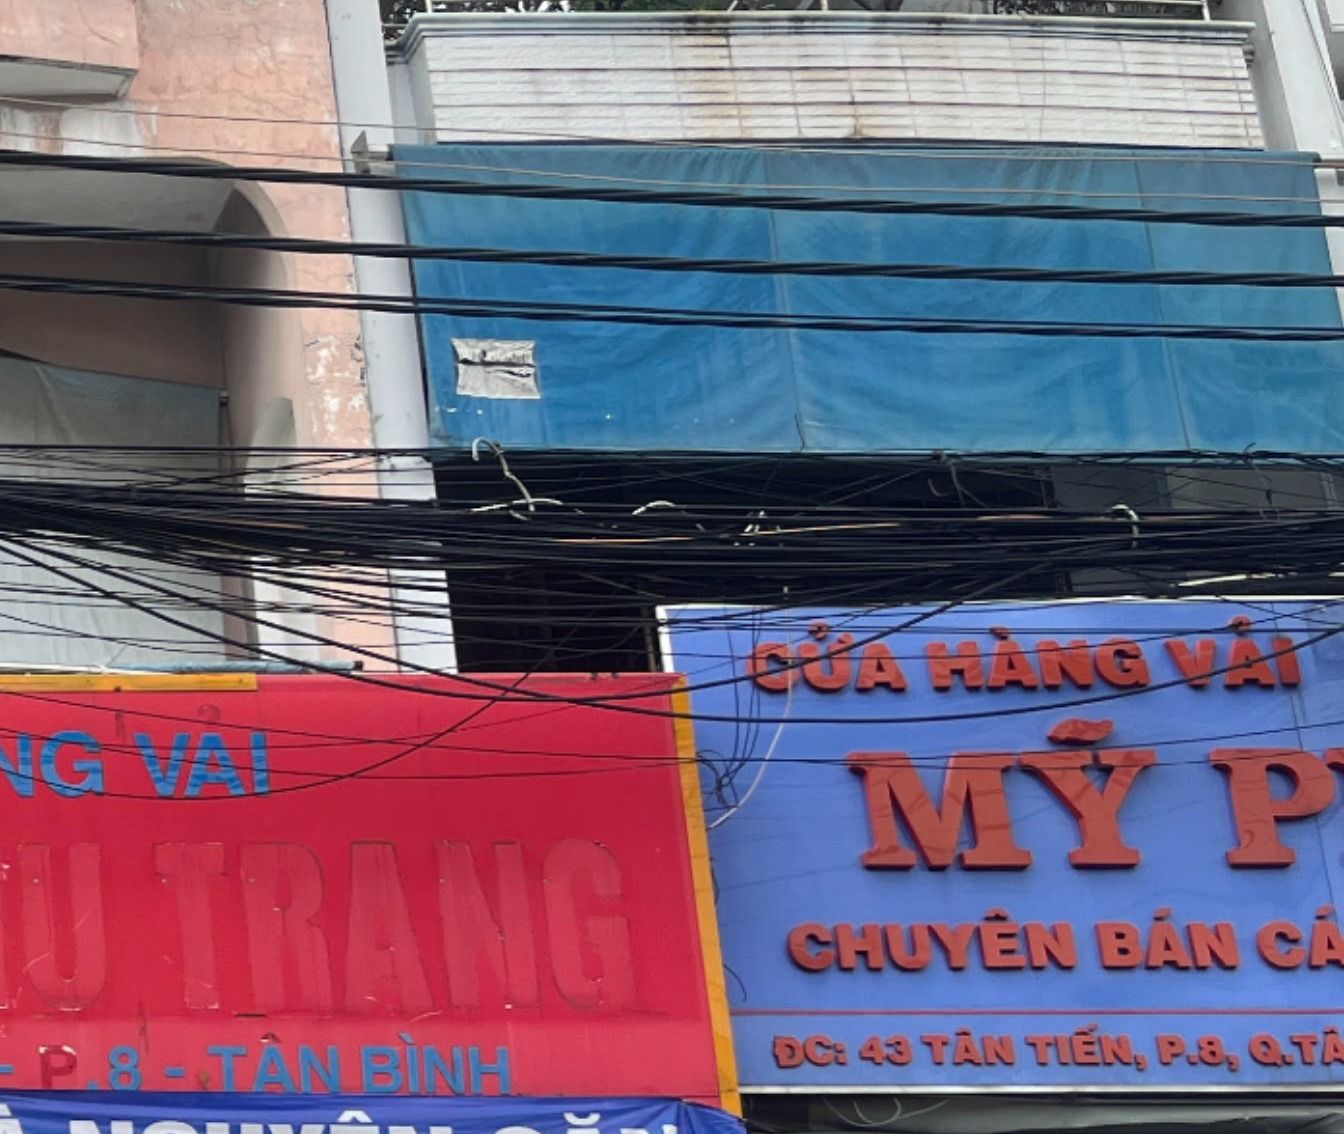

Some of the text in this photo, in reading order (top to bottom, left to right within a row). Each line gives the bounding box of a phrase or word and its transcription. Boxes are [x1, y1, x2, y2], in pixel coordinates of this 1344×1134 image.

[746, 621, 908, 694] CỬA
[924, 626, 1151, 692] HÀNG
[846, 717, 1157, 870] MỸ
[153, 838, 640, 1016] TRANG
[787, 906, 1079, 973] CHUYÊN
[1094, 906, 1240, 970] BÁN
[361, 1031, 512, 1096] BÌNH
[858, 1034, 913, 1066] 43
[921, 1028, 1017, 1067] TÂN
